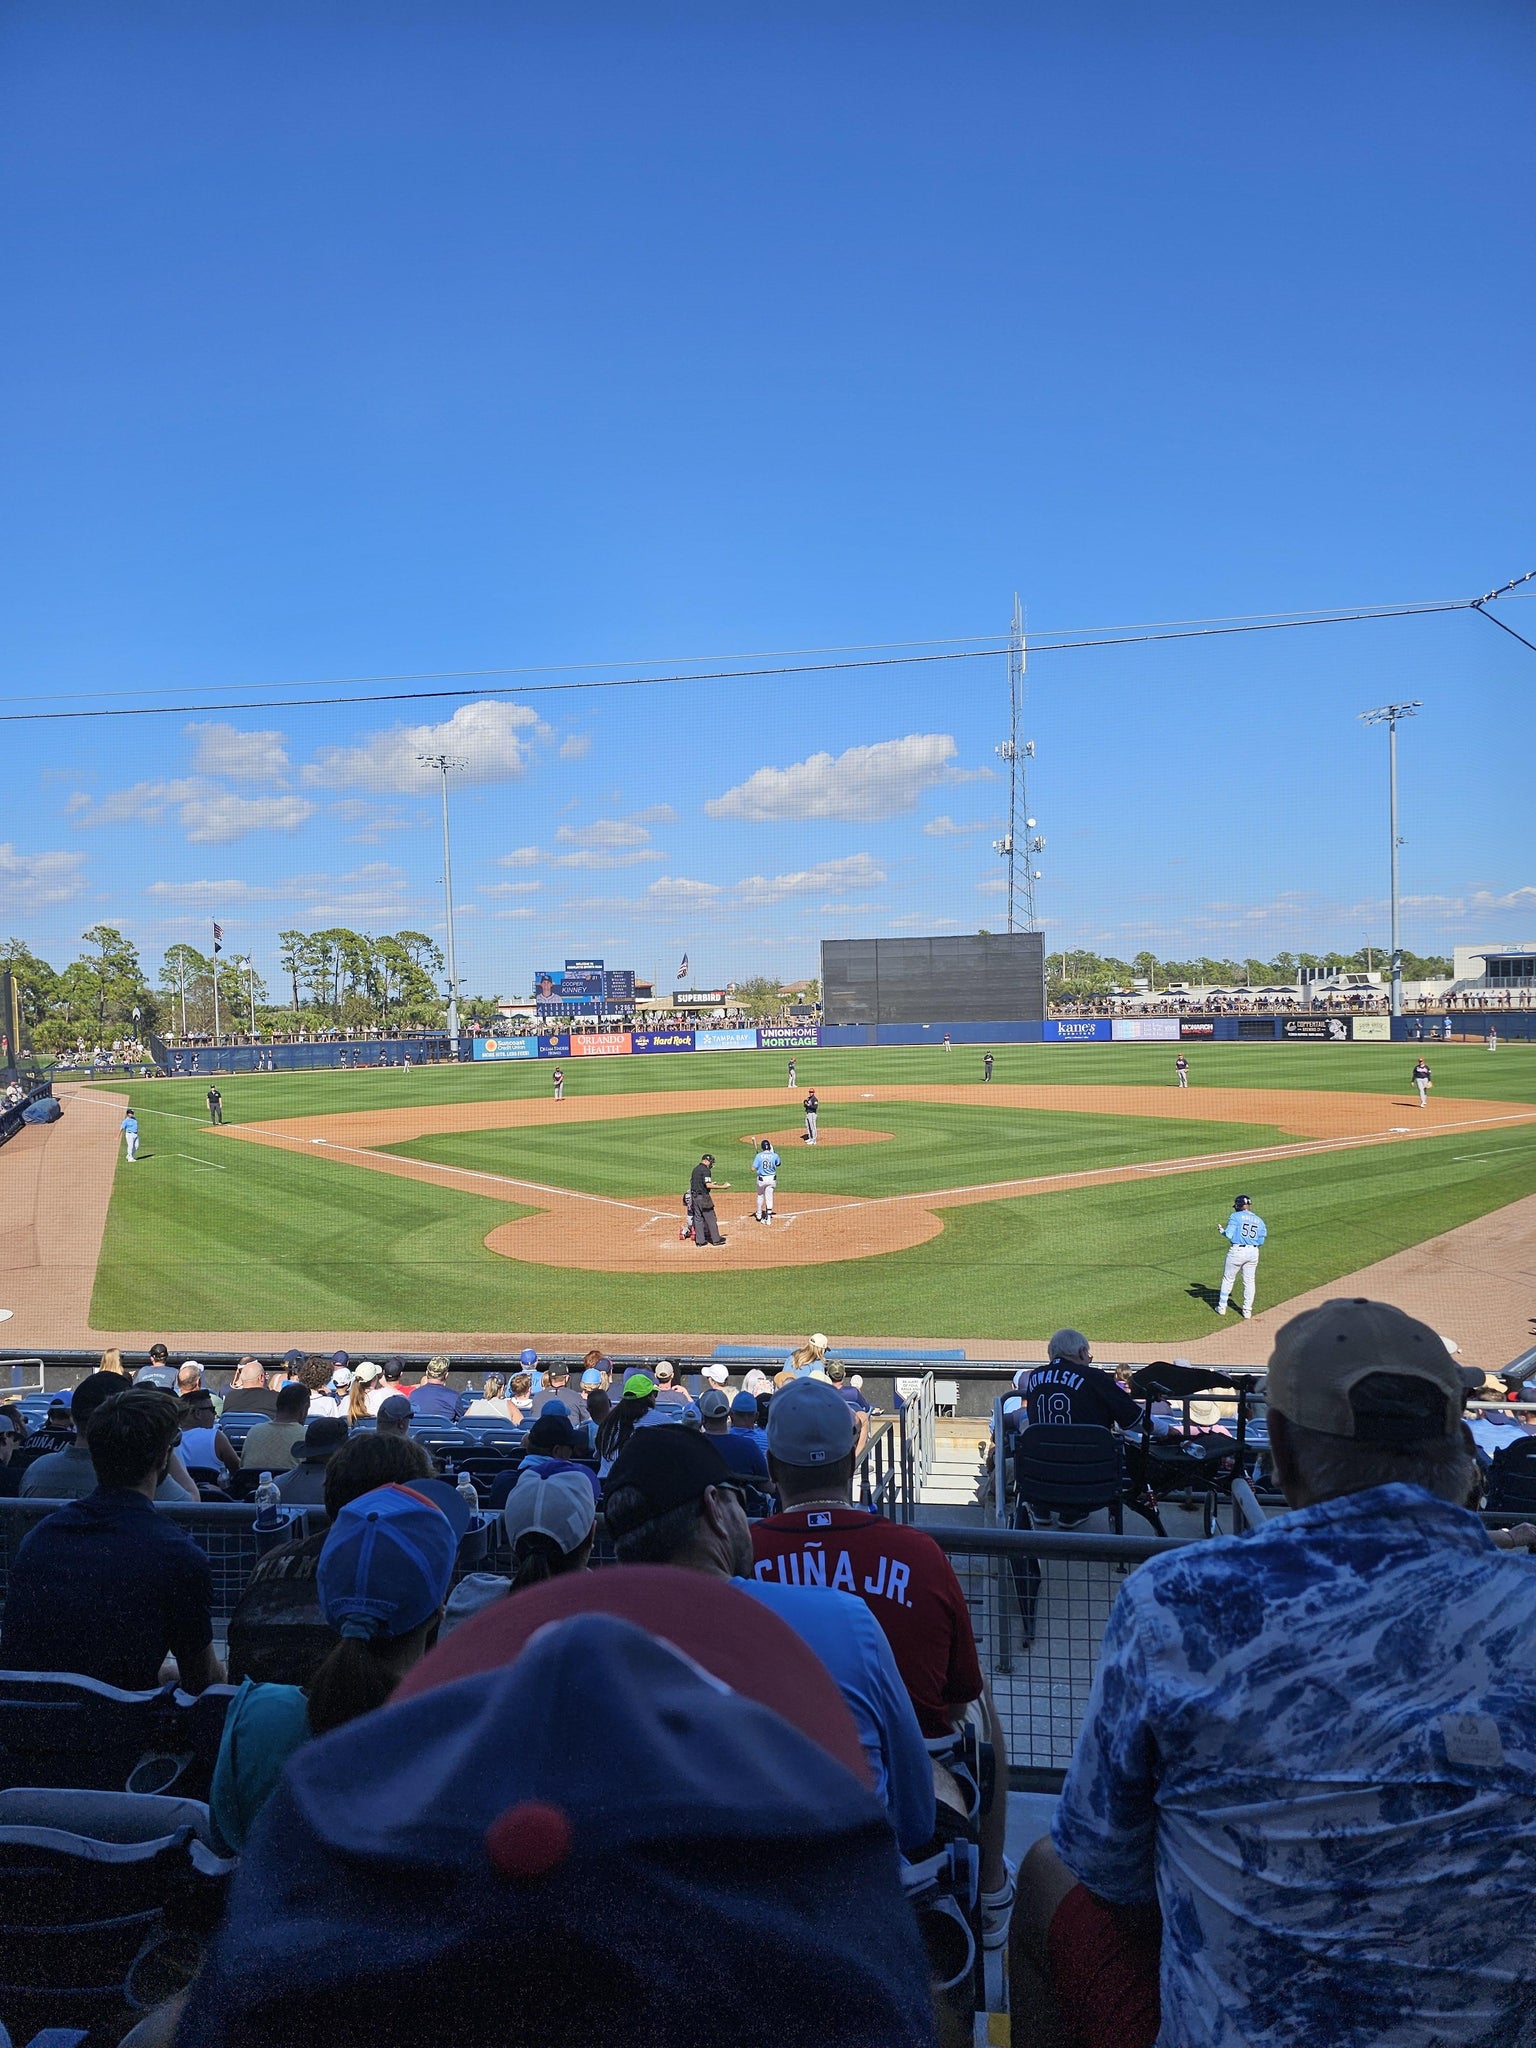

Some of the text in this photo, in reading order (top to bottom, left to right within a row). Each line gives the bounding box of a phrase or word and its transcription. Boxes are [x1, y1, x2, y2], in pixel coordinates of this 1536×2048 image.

[677, 994, 721, 1002] SUPERBIRD
[1058, 1021, 1096, 1032] kane's
[577, 1035, 625, 1045] ORLANDO
[653, 1036, 672, 1046] Hard
[672, 1035, 692, 1047] Rock
[761, 1037, 817, 1047] MORTGAGE
[583, 1045, 620, 1054] HEALTH
[1241, 1223, 1259, 1239] 55
[1037, 1393, 1072, 1424] 18
[25, 1434, 55, 1450] CUÑA
[753, 1541, 913, 1608] CUÑA JR.
